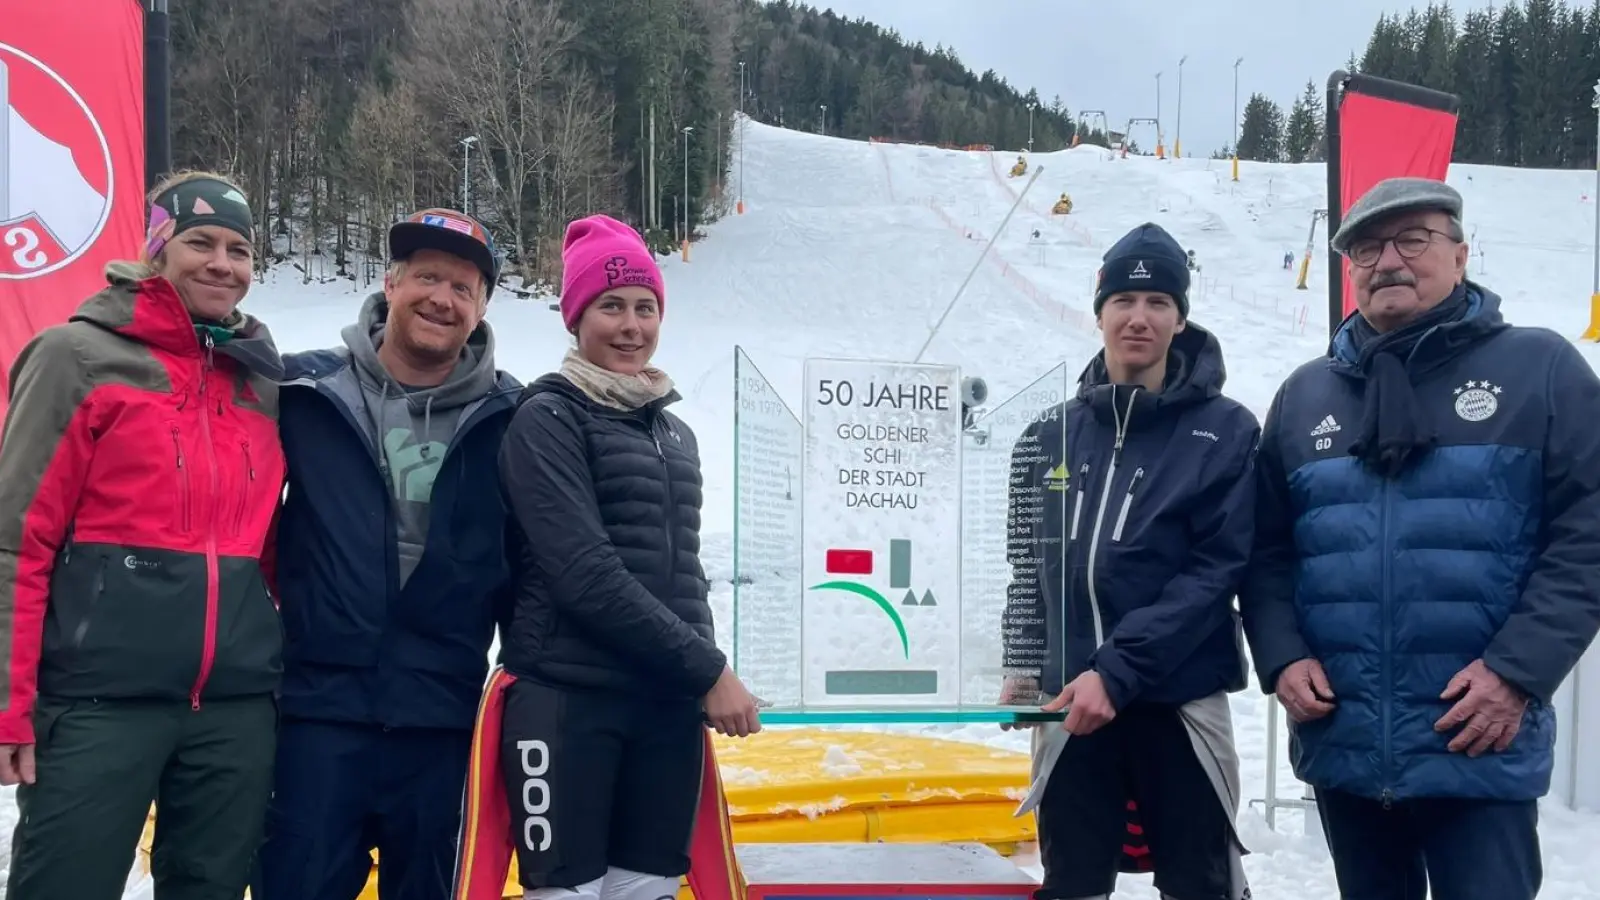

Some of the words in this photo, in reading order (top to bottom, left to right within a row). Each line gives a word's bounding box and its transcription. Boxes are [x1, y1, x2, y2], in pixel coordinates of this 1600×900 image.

[741, 376, 767, 397] 1954
[817, 379, 854, 407] 50
[862, 382, 949, 411] JAHRE
[741, 394, 756, 412] bis
[759, 399, 783, 418] 1979
[1023, 390, 1059, 405] 1980
[1021, 408, 1058, 423] 2004
[836, 423, 929, 444] GOLDENER
[1309, 424, 1342, 438] adidas
[1315, 437, 1333, 451] GD
[863, 447, 902, 465] SCHI
[838, 469, 870, 486] DER
[876, 470, 927, 488] STADT
[845, 492, 918, 510] DACHAU
[516, 739, 552, 852] poc
